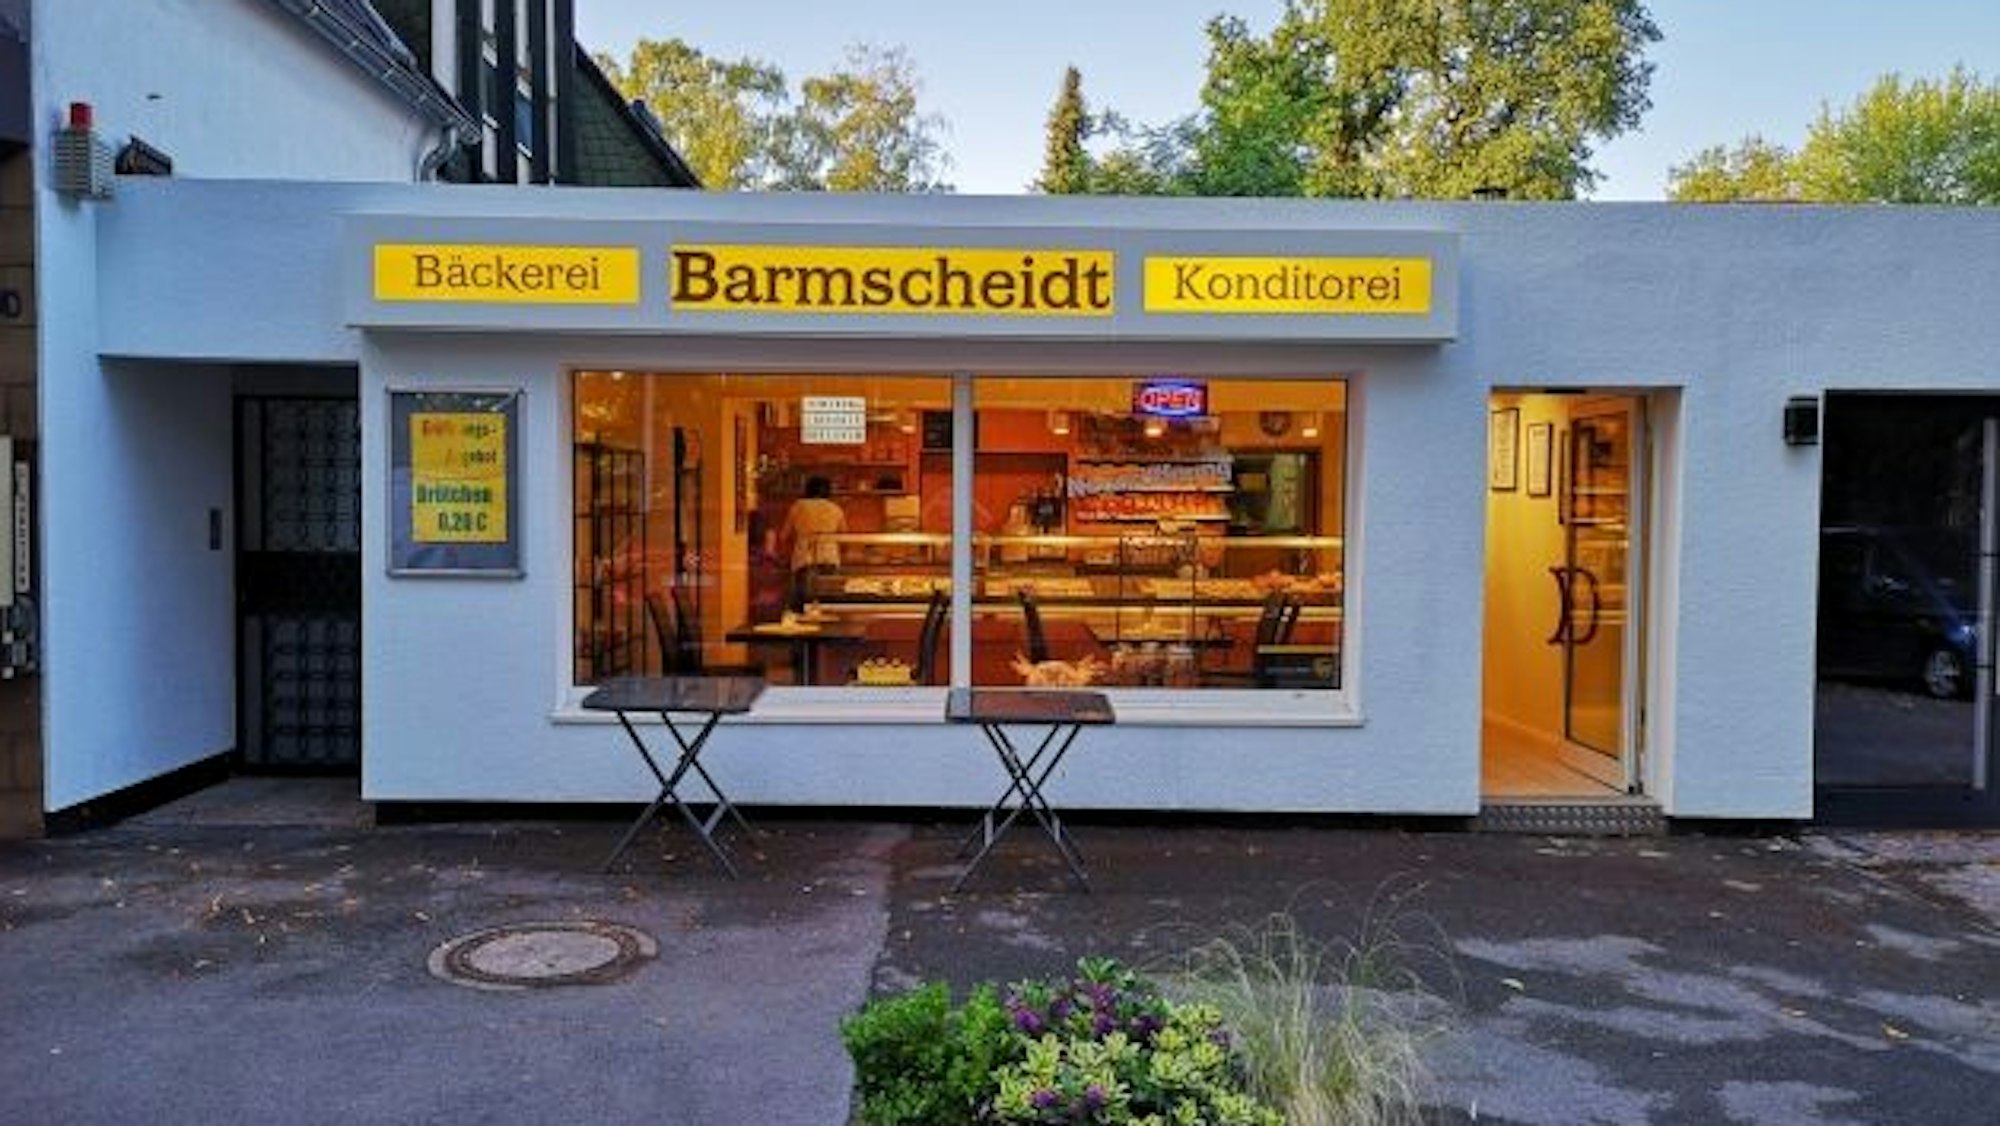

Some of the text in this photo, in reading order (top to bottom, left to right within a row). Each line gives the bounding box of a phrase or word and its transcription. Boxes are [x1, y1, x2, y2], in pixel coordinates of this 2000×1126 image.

[414, 253, 600, 294] Bäckerei
[671, 249, 1110, 310] Barmscheidt
[1173, 262, 1402, 302] Konditorei
[1139, 389, 1200, 409] OPEN
